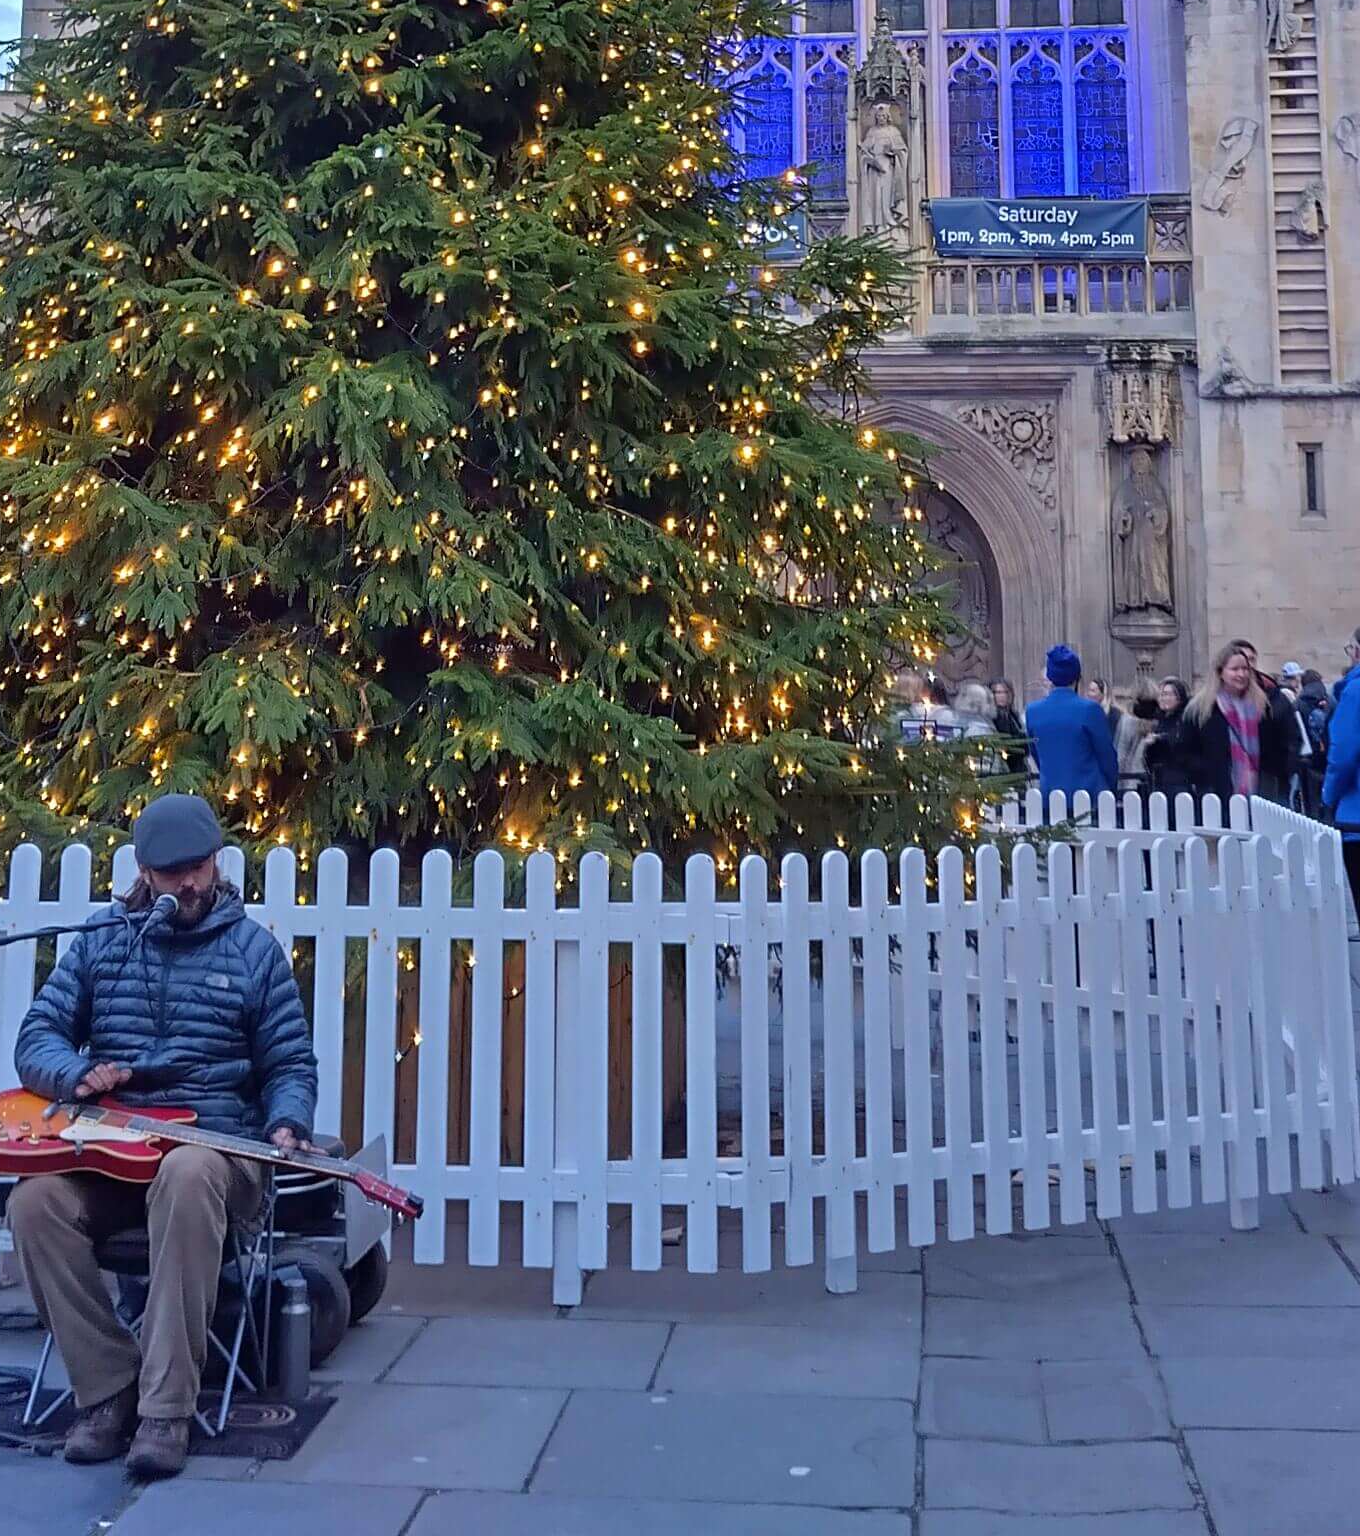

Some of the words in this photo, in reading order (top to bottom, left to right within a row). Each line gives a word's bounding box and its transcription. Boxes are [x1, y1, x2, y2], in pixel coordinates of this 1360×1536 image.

[998, 206, 1079, 226] Saturday
[938, 228, 974, 245] 1pm,
[978, 229, 1015, 246] 2pm,
[1019, 230, 1056, 247] 3pm,
[1060, 231, 1097, 247] 4pm,
[1101, 231, 1134, 247] 5pm
